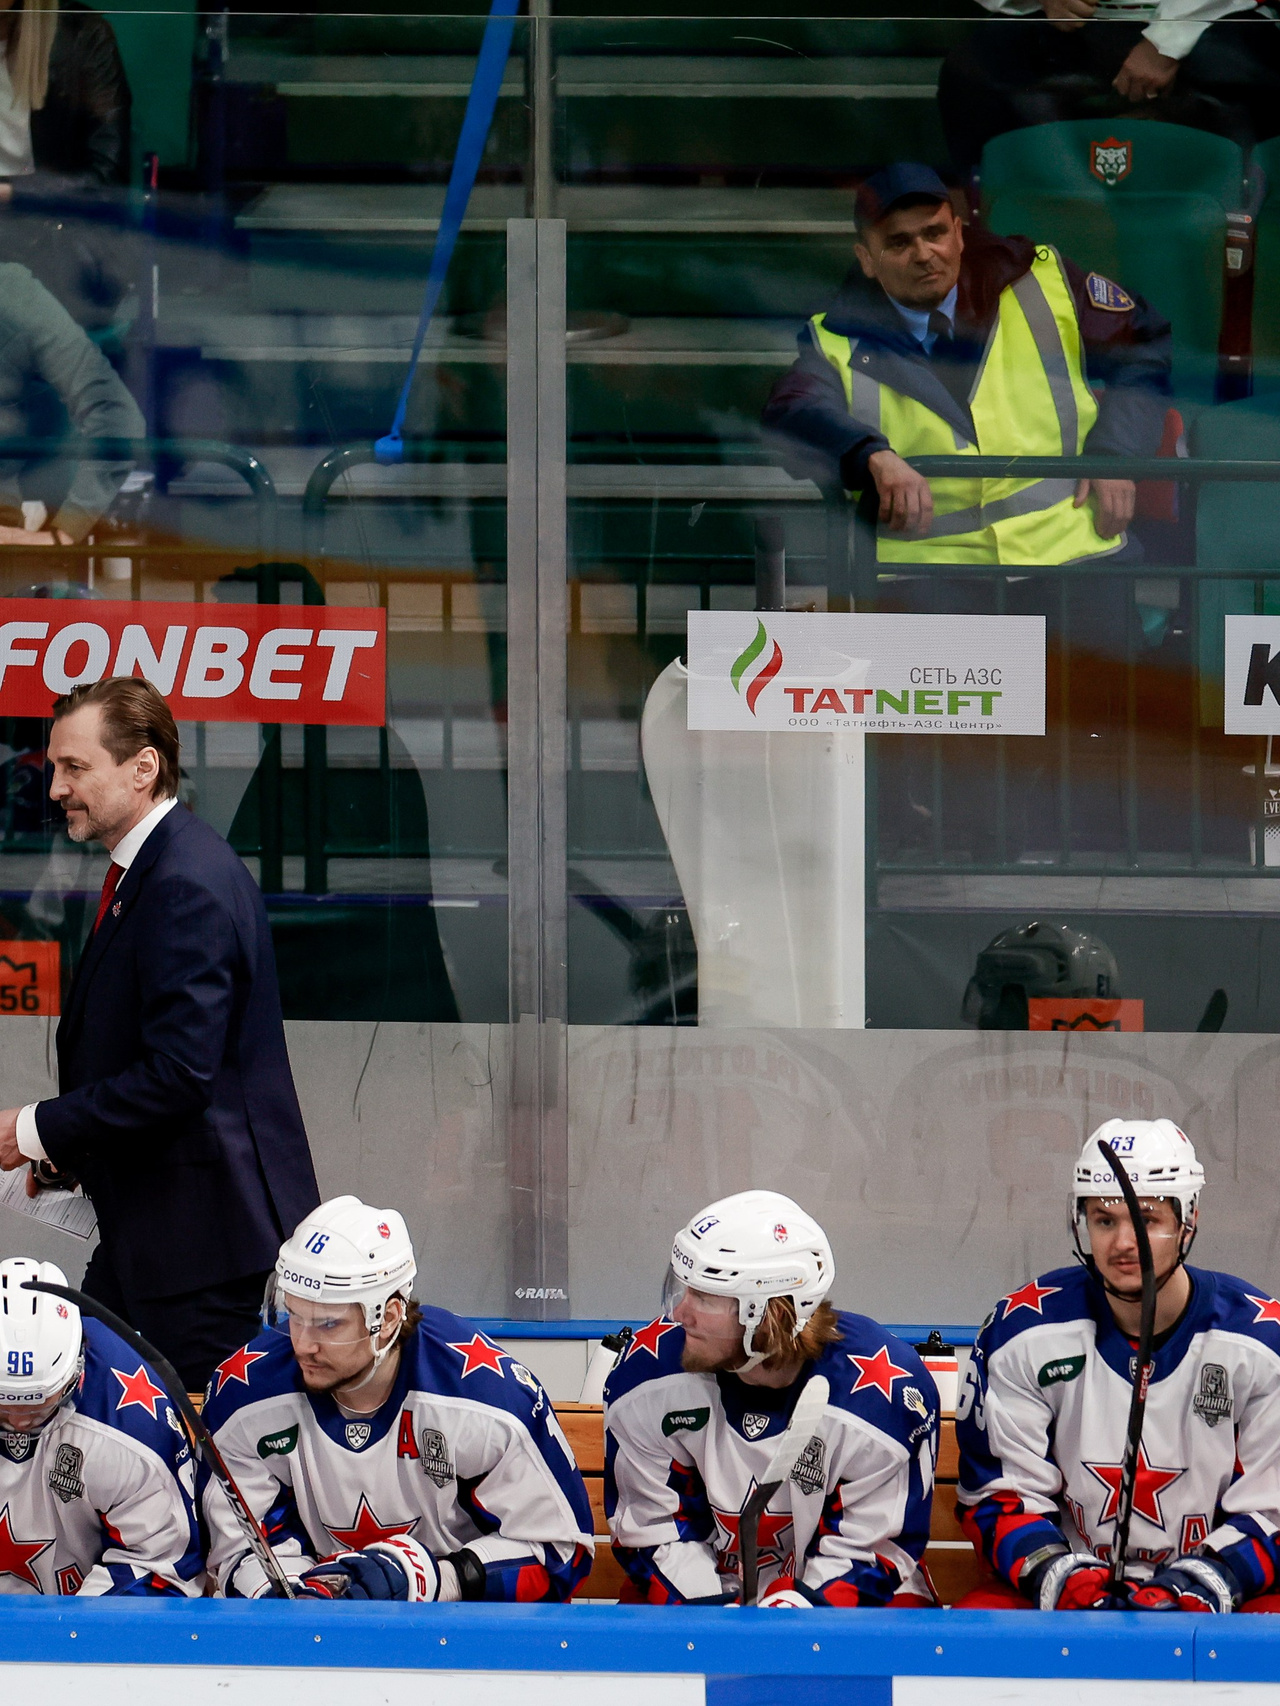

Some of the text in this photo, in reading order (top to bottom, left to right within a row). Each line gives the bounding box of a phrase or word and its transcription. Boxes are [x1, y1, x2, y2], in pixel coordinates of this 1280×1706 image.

[910, 667, 1002, 685] СЕТЬ АЗС
[783, 687, 1002, 716] TATNEFT
[788, 718, 1003, 730] ООО «Татнефть-АЗС Центр»
[1109, 1136, 1135, 1152] 63
[694, 1215, 721, 1235] 13
[304, 1231, 330, 1255] 16
[283, 1269, 321, 1290] согаз
[525, 1287, 567, 1300] RAITA
[7, 1350, 34, 1376] 96
[49, 1471, 85, 1492] ФИНАЛ
